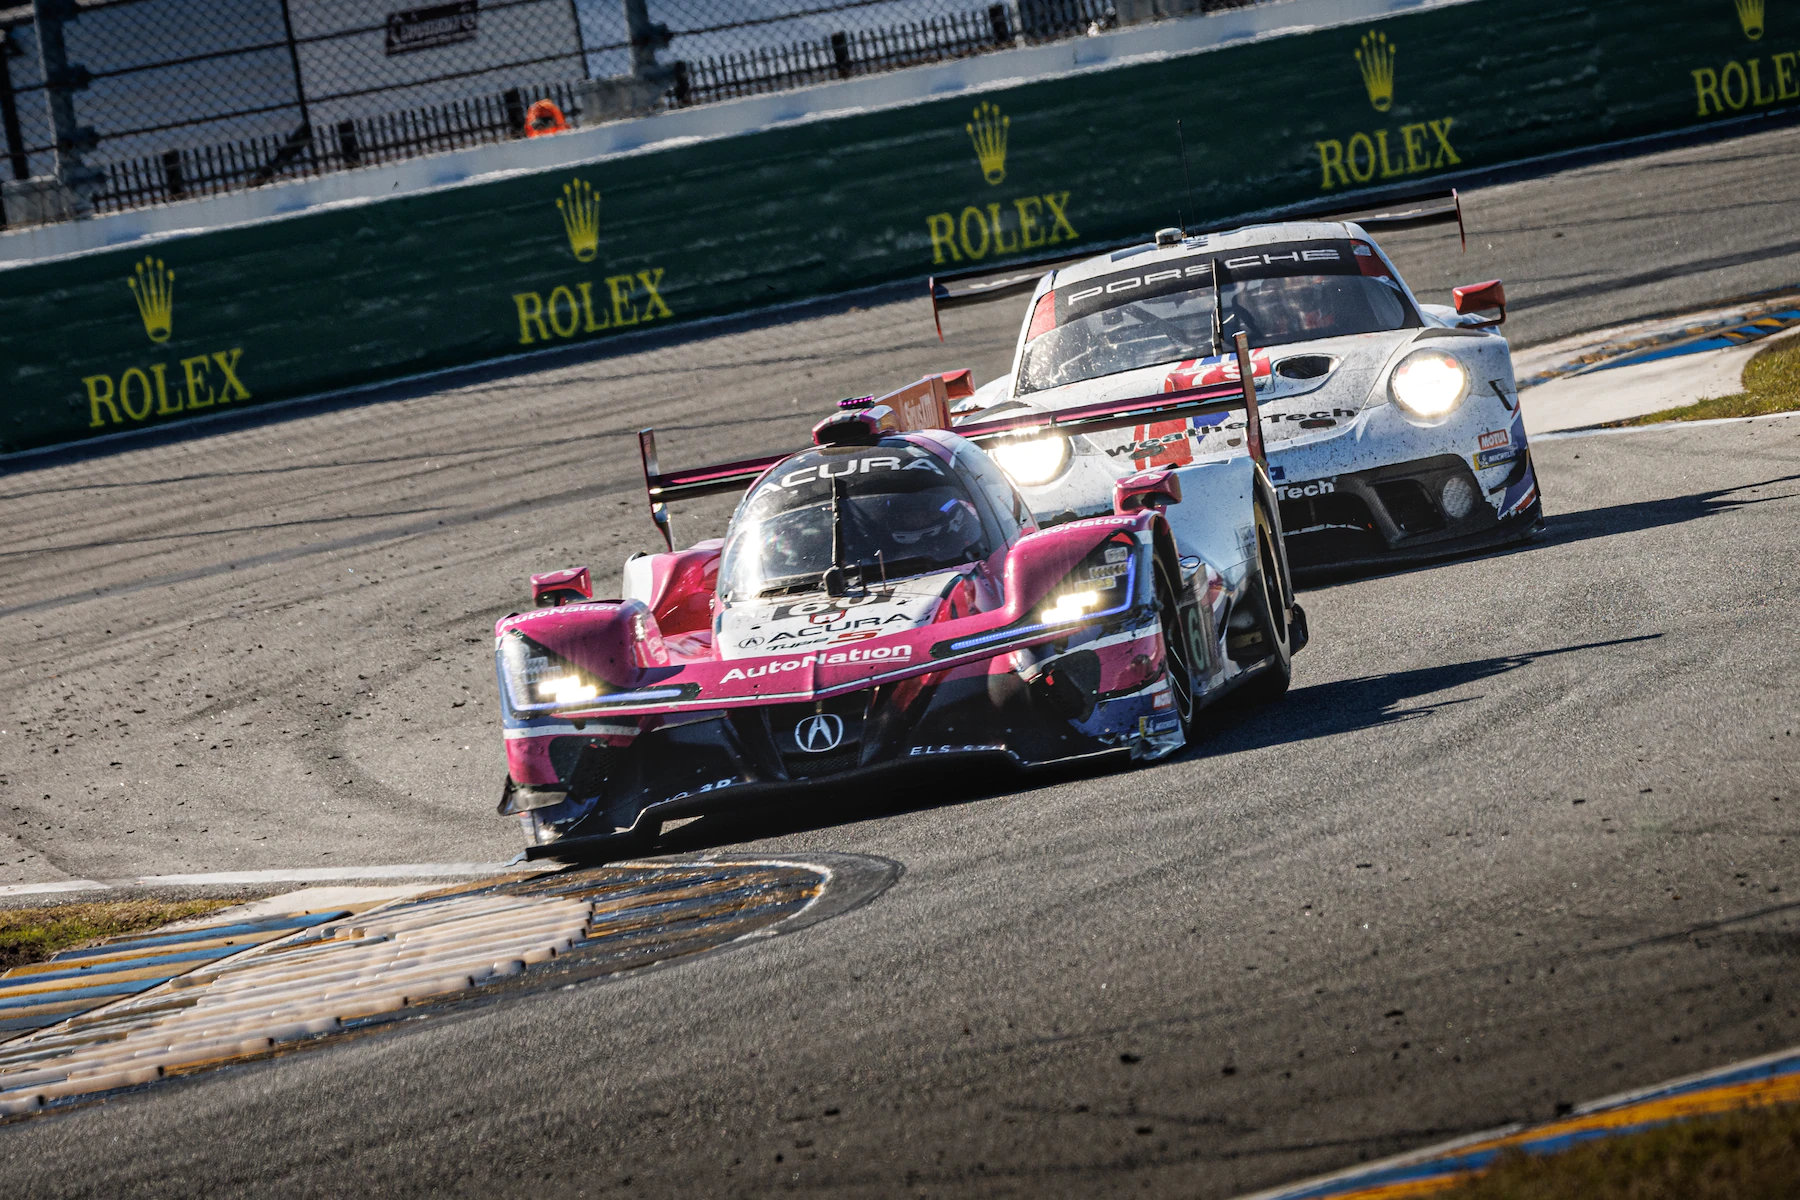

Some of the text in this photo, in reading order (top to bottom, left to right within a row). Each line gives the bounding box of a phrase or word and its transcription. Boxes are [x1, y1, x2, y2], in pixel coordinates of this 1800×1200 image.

[1690, 51, 1800, 117] ROLE
[1315, 117, 1461, 189] ROLEX
[926, 190, 1080, 265] ROLEX
[1067, 249, 1341, 306] PORSCHE
[512, 267, 675, 344] ROLEX
[81, 348, 251, 427] ROLEX
[1104, 407, 1356, 458] WeatheTech
[749, 456, 945, 504] ACURA
[1016, 517, 1138, 547] toNation
[499, 603, 622, 633] AutoNation
[767, 613, 913, 643] ACURA
[827, 627, 884, 645] S
[719, 644, 912, 684] AutoNation
[910, 745, 951, 756] ELS
